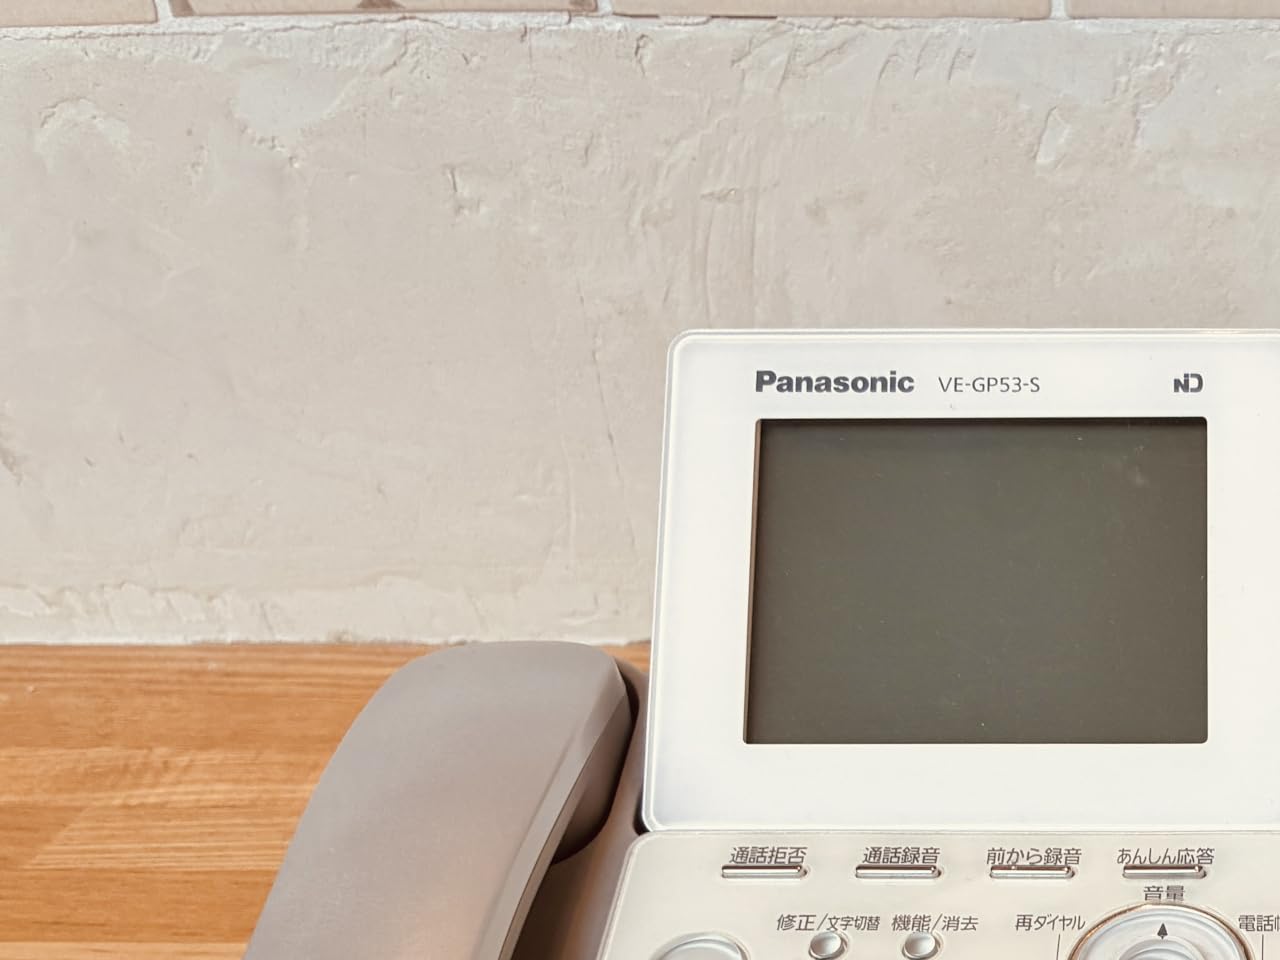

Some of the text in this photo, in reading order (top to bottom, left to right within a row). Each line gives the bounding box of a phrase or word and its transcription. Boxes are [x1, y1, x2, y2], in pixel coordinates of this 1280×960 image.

[755, 370, 1040, 393] Panasonic VE-GP53-S
[730, 846, 807, 864] 通話拒否
[862, 846, 940, 864] 通話録音
[986, 847, 1082, 865] 前から録音
[1117, 847, 1215, 865] あんしん応答
[1143, 885, 1185, 901] 音量
[776, 913, 881, 931] 修正/文字切替
[891, 913, 978, 932] 機能/消去
[1014, 914, 1087, 931] 再ダイヤル
